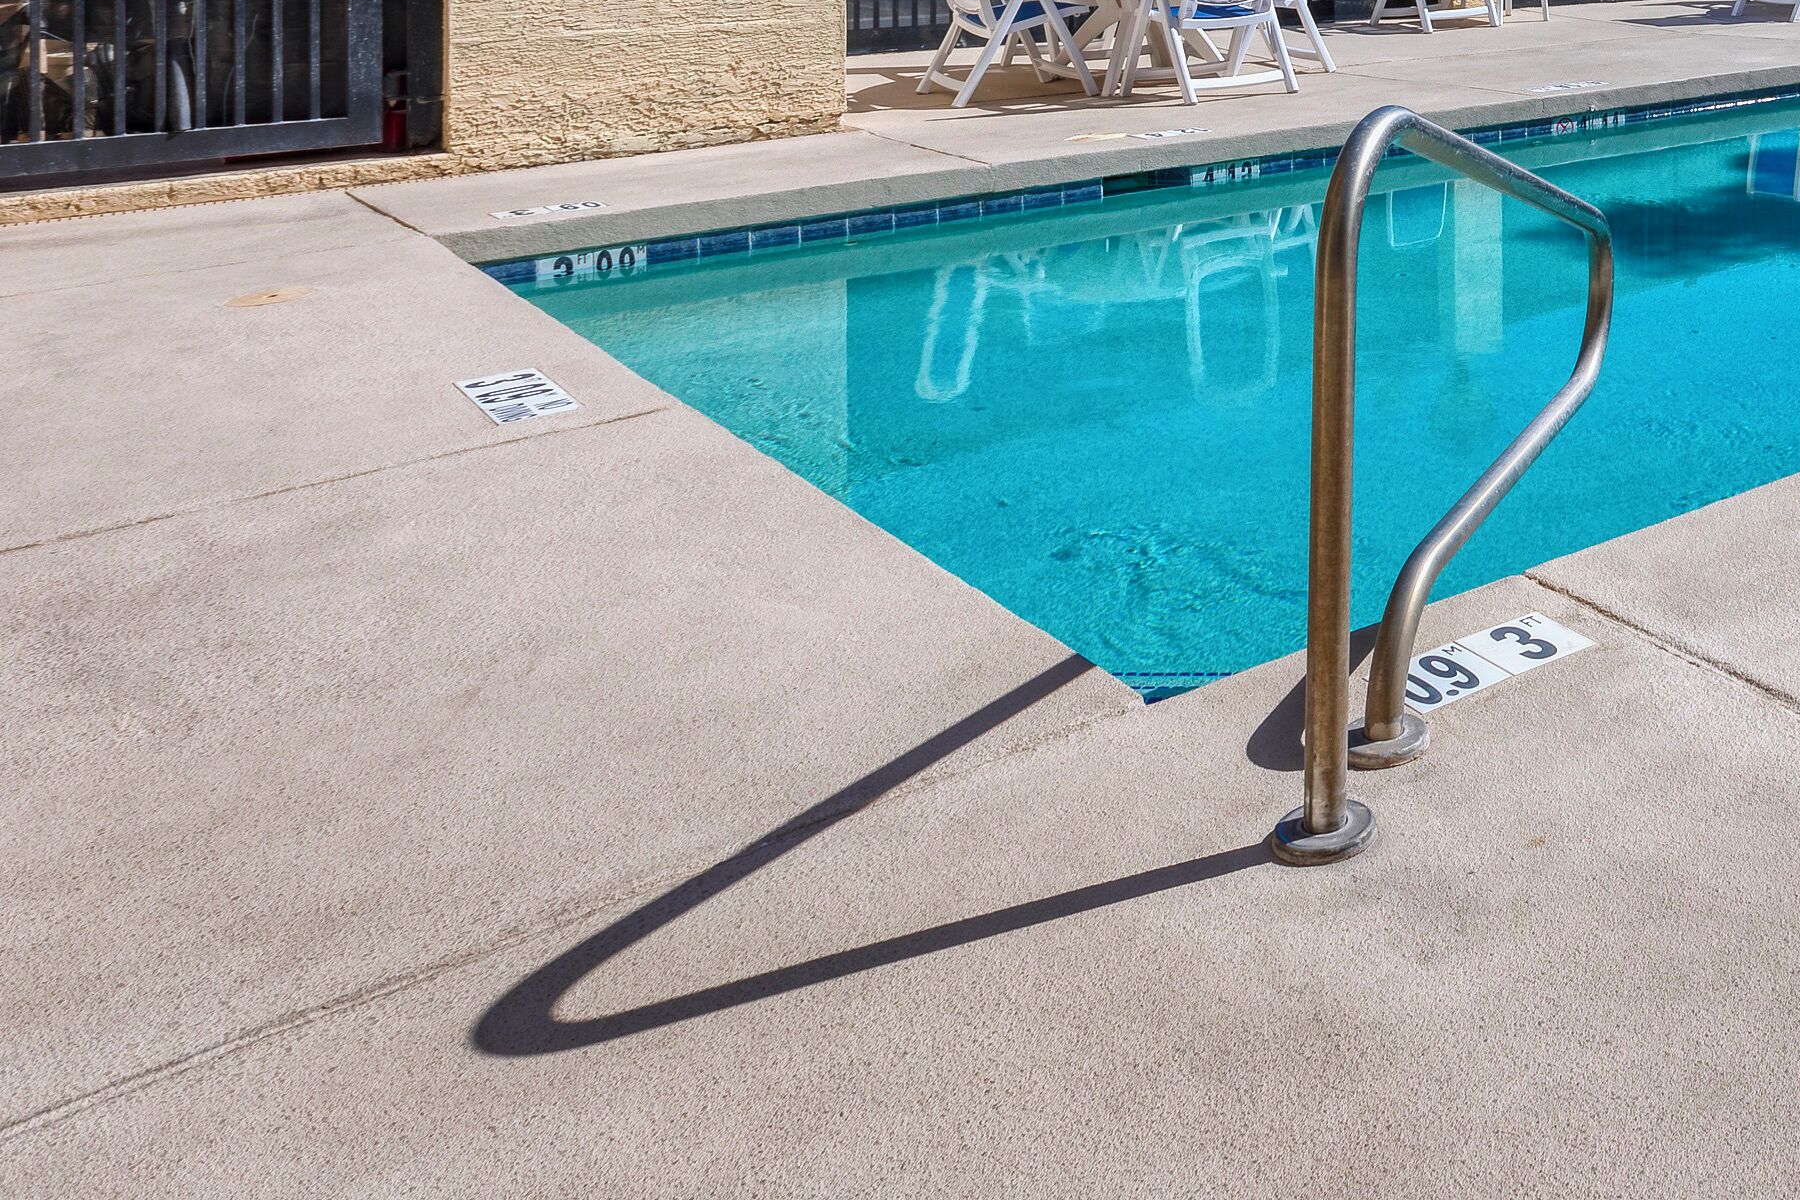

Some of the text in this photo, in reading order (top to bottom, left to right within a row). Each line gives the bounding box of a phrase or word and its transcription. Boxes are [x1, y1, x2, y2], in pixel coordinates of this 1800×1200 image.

[1519, 615, 1542, 628] FT
[1489, 626, 1558, 659] 3
[1445, 645, 1462, 656] M
